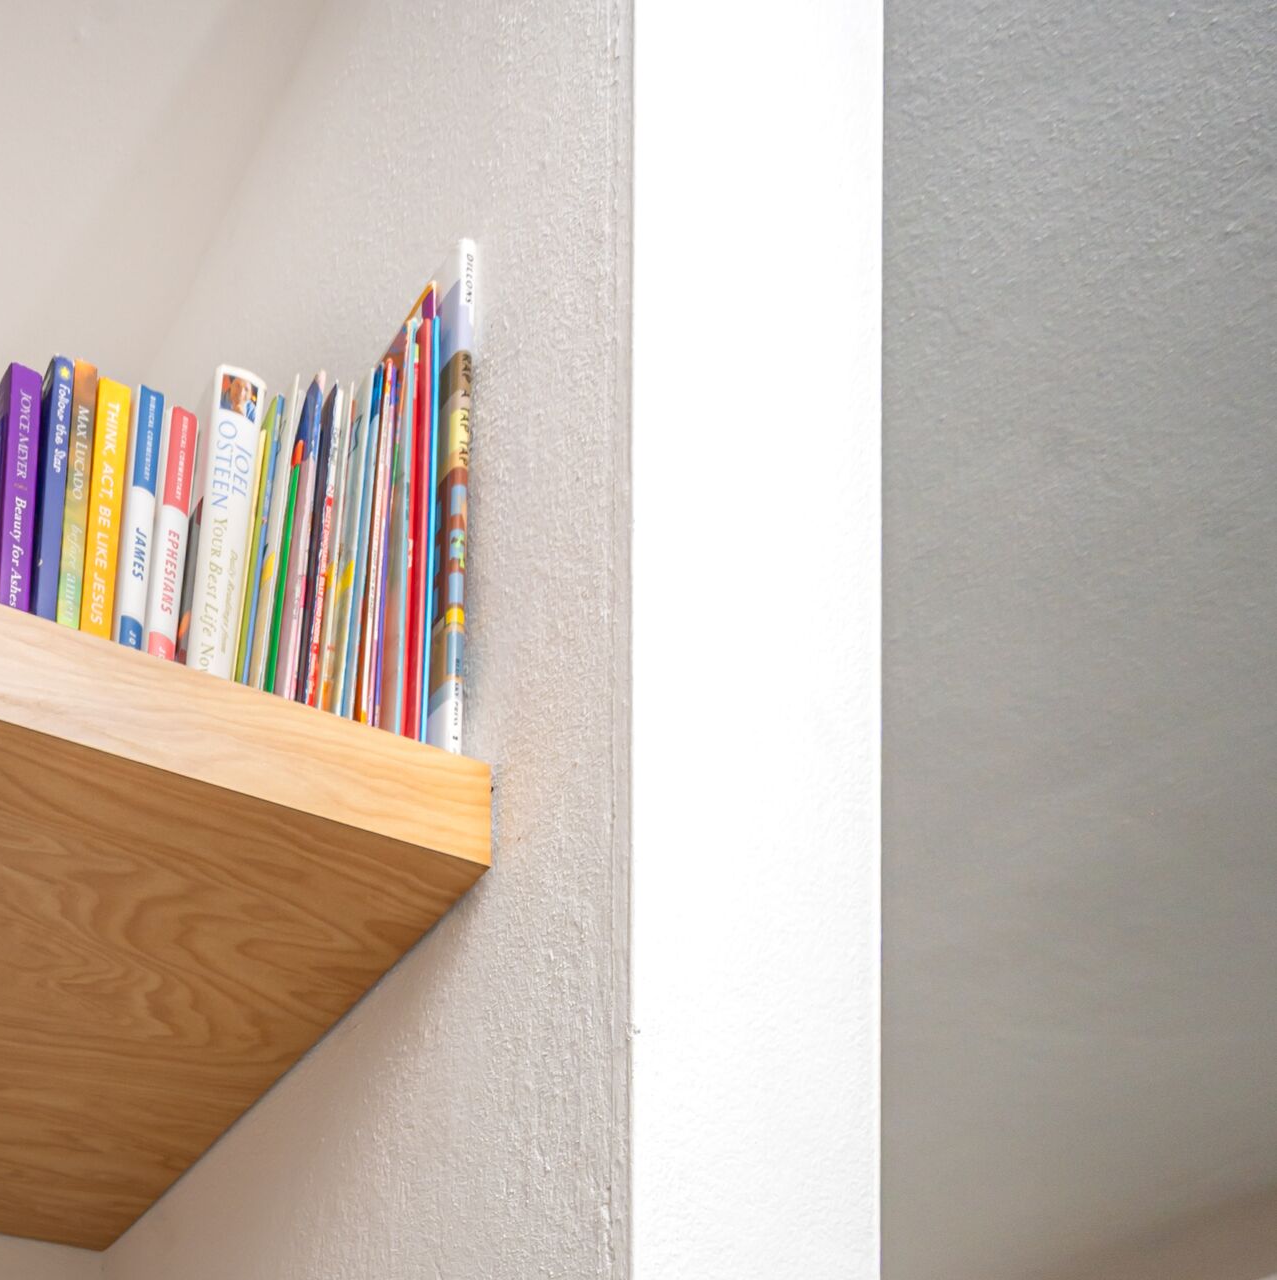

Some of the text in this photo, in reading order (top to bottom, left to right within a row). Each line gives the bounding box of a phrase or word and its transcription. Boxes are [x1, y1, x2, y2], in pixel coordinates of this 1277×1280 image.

[464, 253, 475, 305] DILLONS
[16, 388, 32, 479] JOYCE MEYER
[53, 383, 70, 474] Follow the Star
[147, 395, 157, 429] BIBLICAL
[180, 415, 190, 449] BIBLICAL
[72, 404, 90, 500] MAX LUCADO
[210, 420, 238, 511] OSTEEN
[232, 442, 253, 497] JOEL
[66, 524, 83, 571] before
[90, 402, 121, 625] THINK, ACT, BE LIKE JESUS
[9, 496, 27, 608] Beauty for Ashes
[132, 527, 148, 582] JAMES
[160, 529, 180, 616] EPHESIANS
[199, 603, 219, 637] Life
